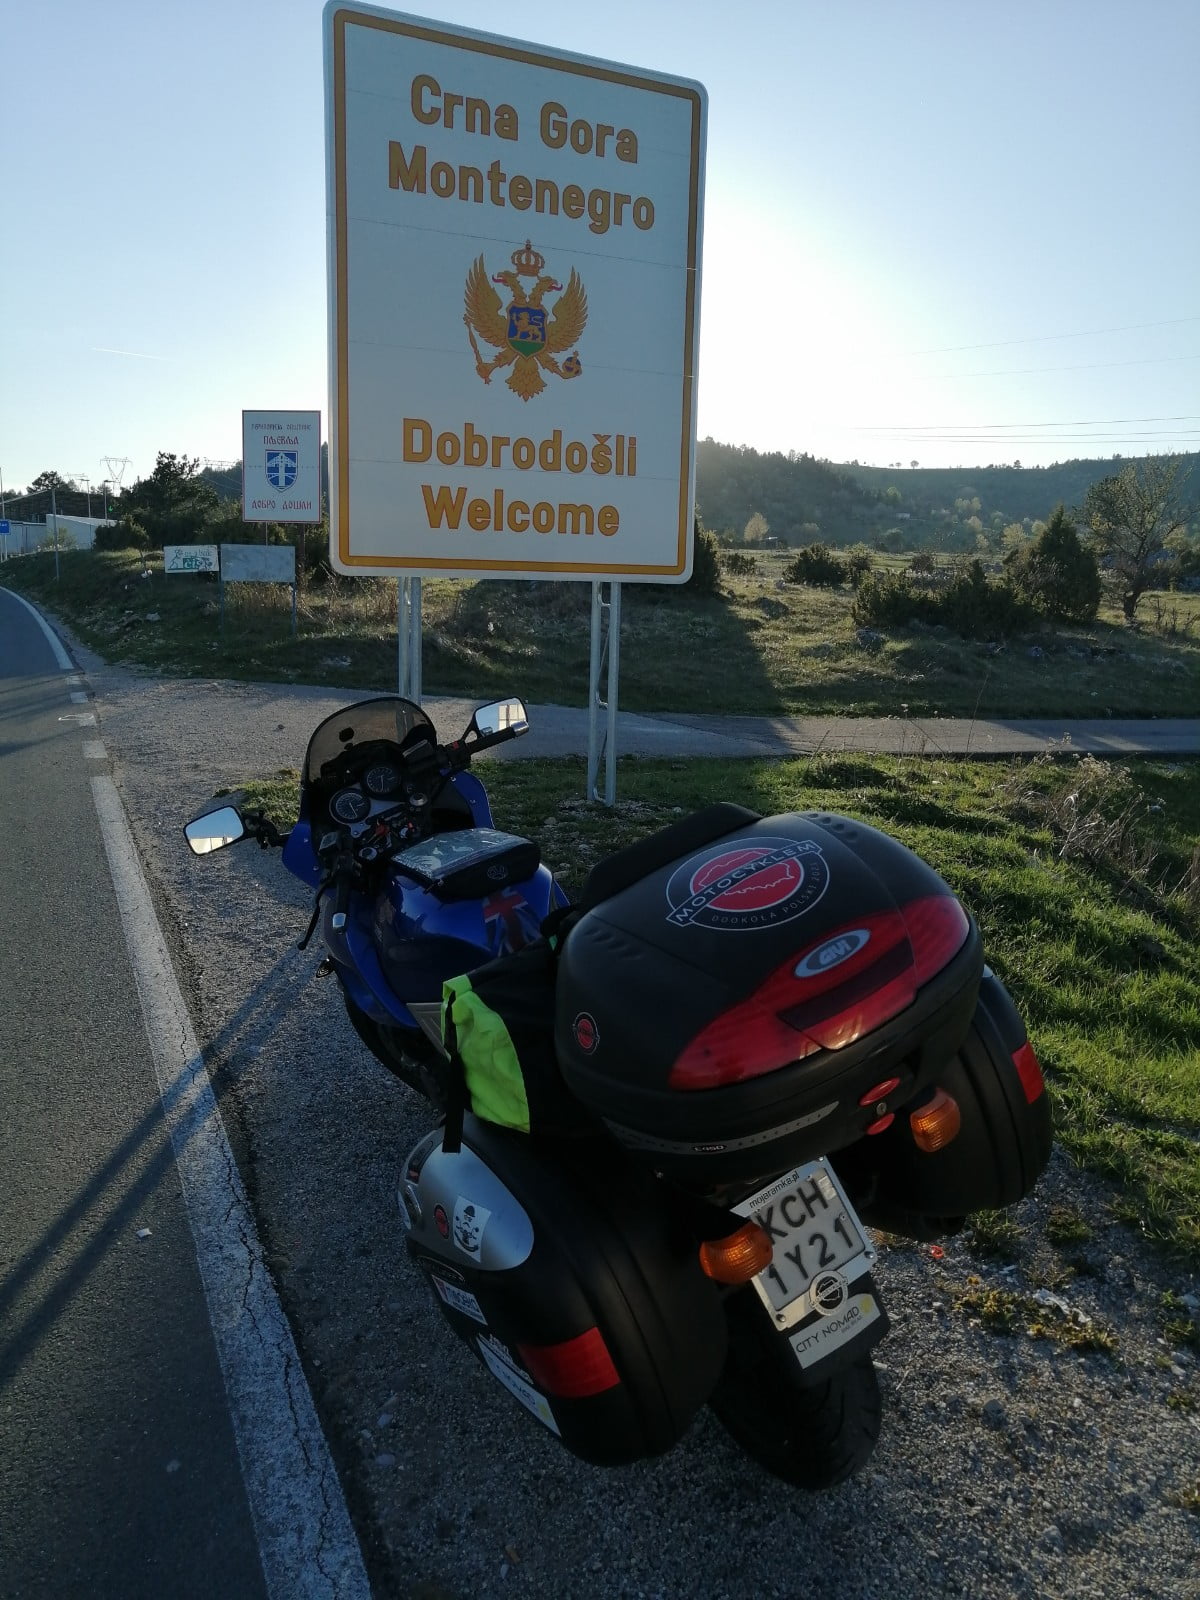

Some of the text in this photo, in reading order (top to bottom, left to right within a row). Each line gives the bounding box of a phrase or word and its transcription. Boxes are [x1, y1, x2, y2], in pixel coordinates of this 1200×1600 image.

[411, 74, 639, 164] Crna Gora
[388, 141, 656, 235] Montenegro
[402, 418, 638, 477] Dobrodošli
[251, 499, 276, 510] ДОБРО
[421, 484, 620, 538] Welcome
[675, 842, 815, 922] MOTOCYKLEM
[749, 1170, 800, 1209] mojaramka.pl
[756, 1177, 829, 1245] KCH
[768, 1216, 854, 1295] 1Y21
[795, 1332, 820, 1354] CITY
[822, 1305, 860, 1340] NOMAD
